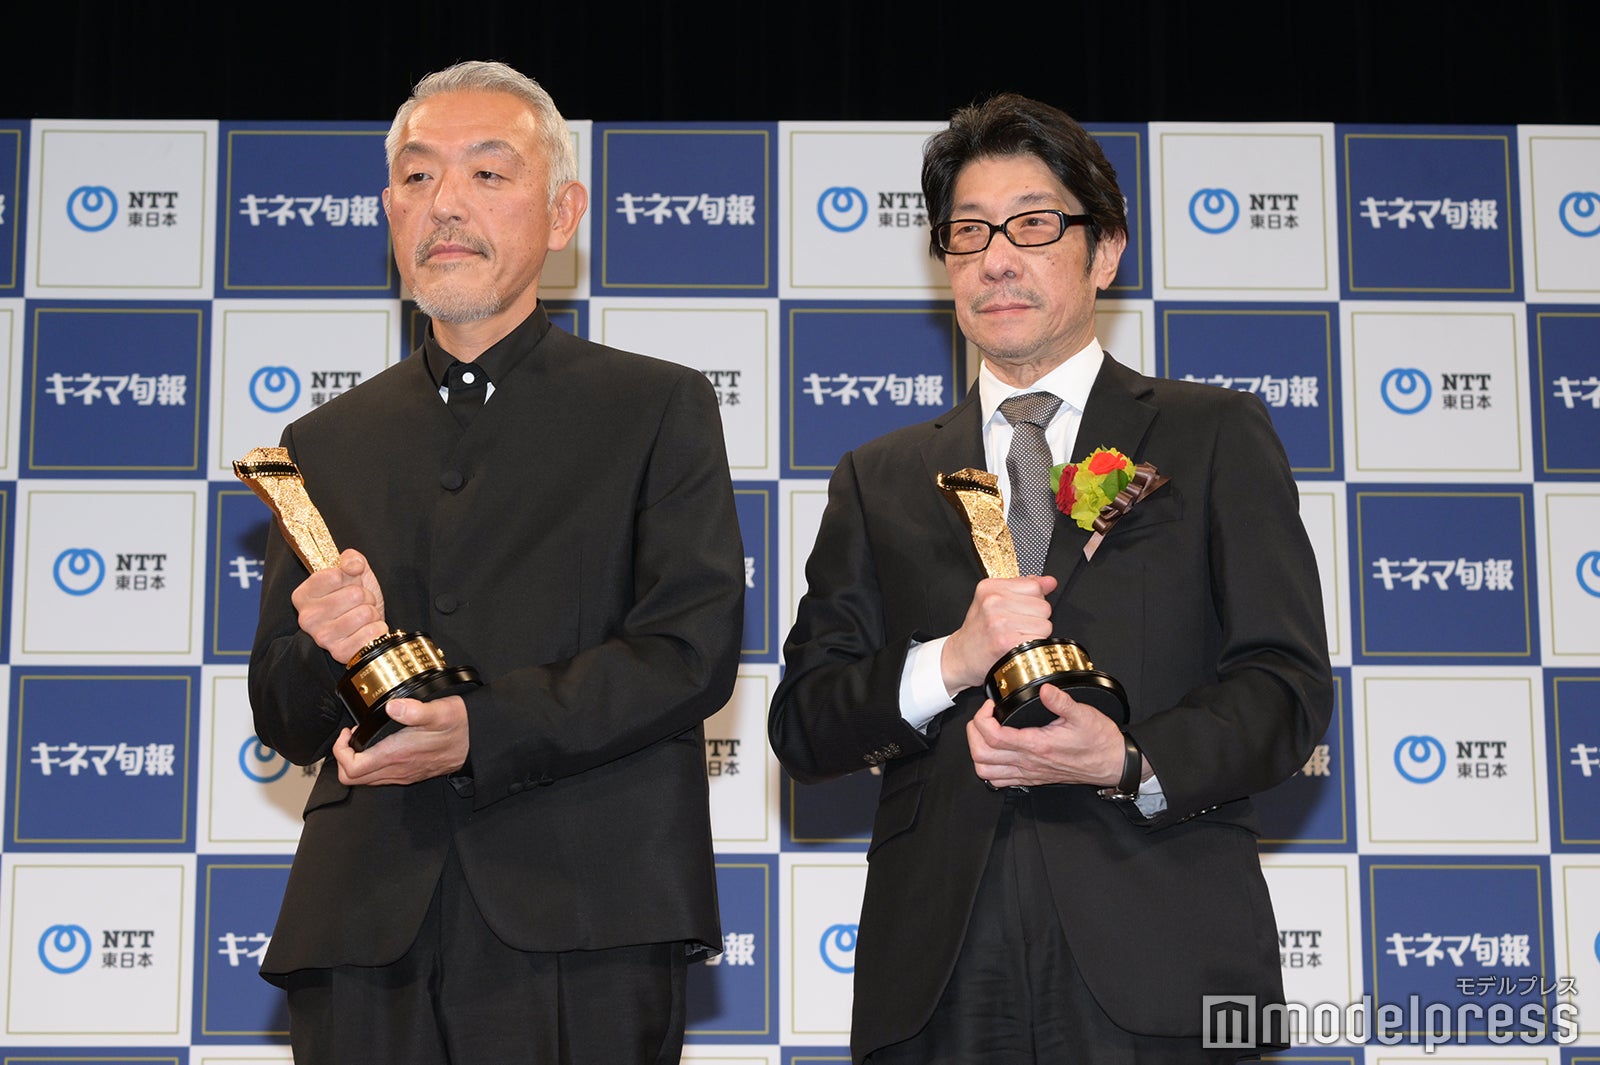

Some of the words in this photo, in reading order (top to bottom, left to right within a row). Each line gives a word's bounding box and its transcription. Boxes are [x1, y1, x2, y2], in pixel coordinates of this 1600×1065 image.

[128, 191, 178, 209] NTT
[616, 193, 755, 225] キネマ旬報
[878, 192, 926, 209] NTT
[1249, 194, 1299, 211] NTT
[240, 193, 379, 226] キネマ旬報
[1360, 197, 1498, 230] キネマ旬報
[128, 212, 177, 227] 東日本
[878, 212, 927, 227] 東日本
[1251, 214, 1299, 229] 東日本
[311, 371, 361, 388] NTT
[701, 370, 741, 388] TT
[1441, 374, 1491, 391] NTT
[45, 373, 187, 405] キネマ旬報
[803, 373, 943, 405] キネマ旬報
[1442, 394, 1492, 409] 東日本
[116, 554, 167, 571] NTT
[229, 556, 265, 589] キ
[1372, 557, 1514, 591] キネマ旬報
[115, 575, 165, 590] 東日本
[705, 739, 741, 757] TT
[1456, 741, 1507, 759] NTT
[30, 743, 175, 775] キネマ旬報
[708, 760, 741, 776] 日本
[1570, 743, 1600, 777] キ
[1457, 762, 1508, 778] 東日本
[102, 931, 154, 949] NTT
[1385, 932, 1531, 967] キネマ旬報
[101, 953, 153, 969] 東日本
